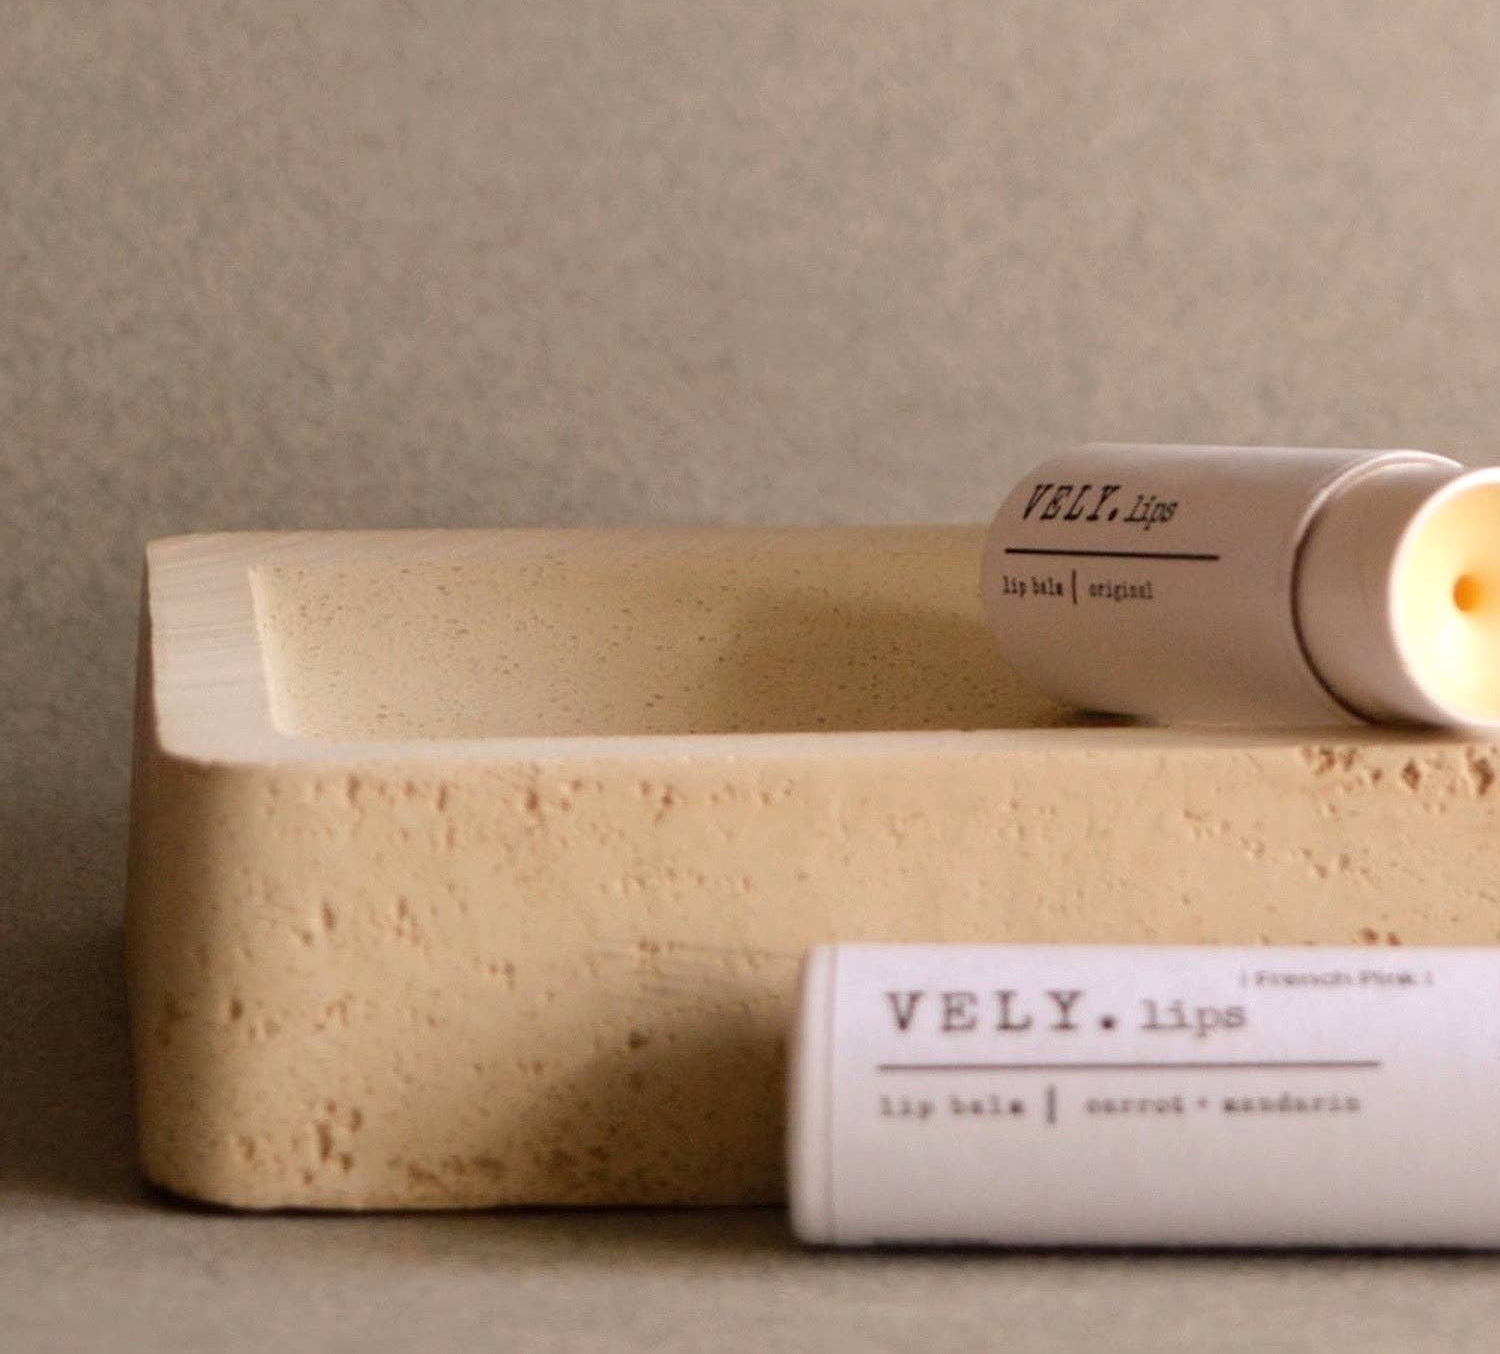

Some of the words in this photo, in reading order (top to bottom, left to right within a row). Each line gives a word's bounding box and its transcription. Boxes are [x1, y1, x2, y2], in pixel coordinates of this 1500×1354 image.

[1021, 483, 1121, 521] VELY.
[1122, 495, 1180, 531] lips
[1002, 574, 1026, 598] lip
[1088, 579, 1153, 602] original
[884, 989, 1117, 1032] VELY.
[1140, 998, 1248, 1038] lips
[878, 1092, 935, 1120] lip
[1083, 1094, 1187, 1116] carrot
